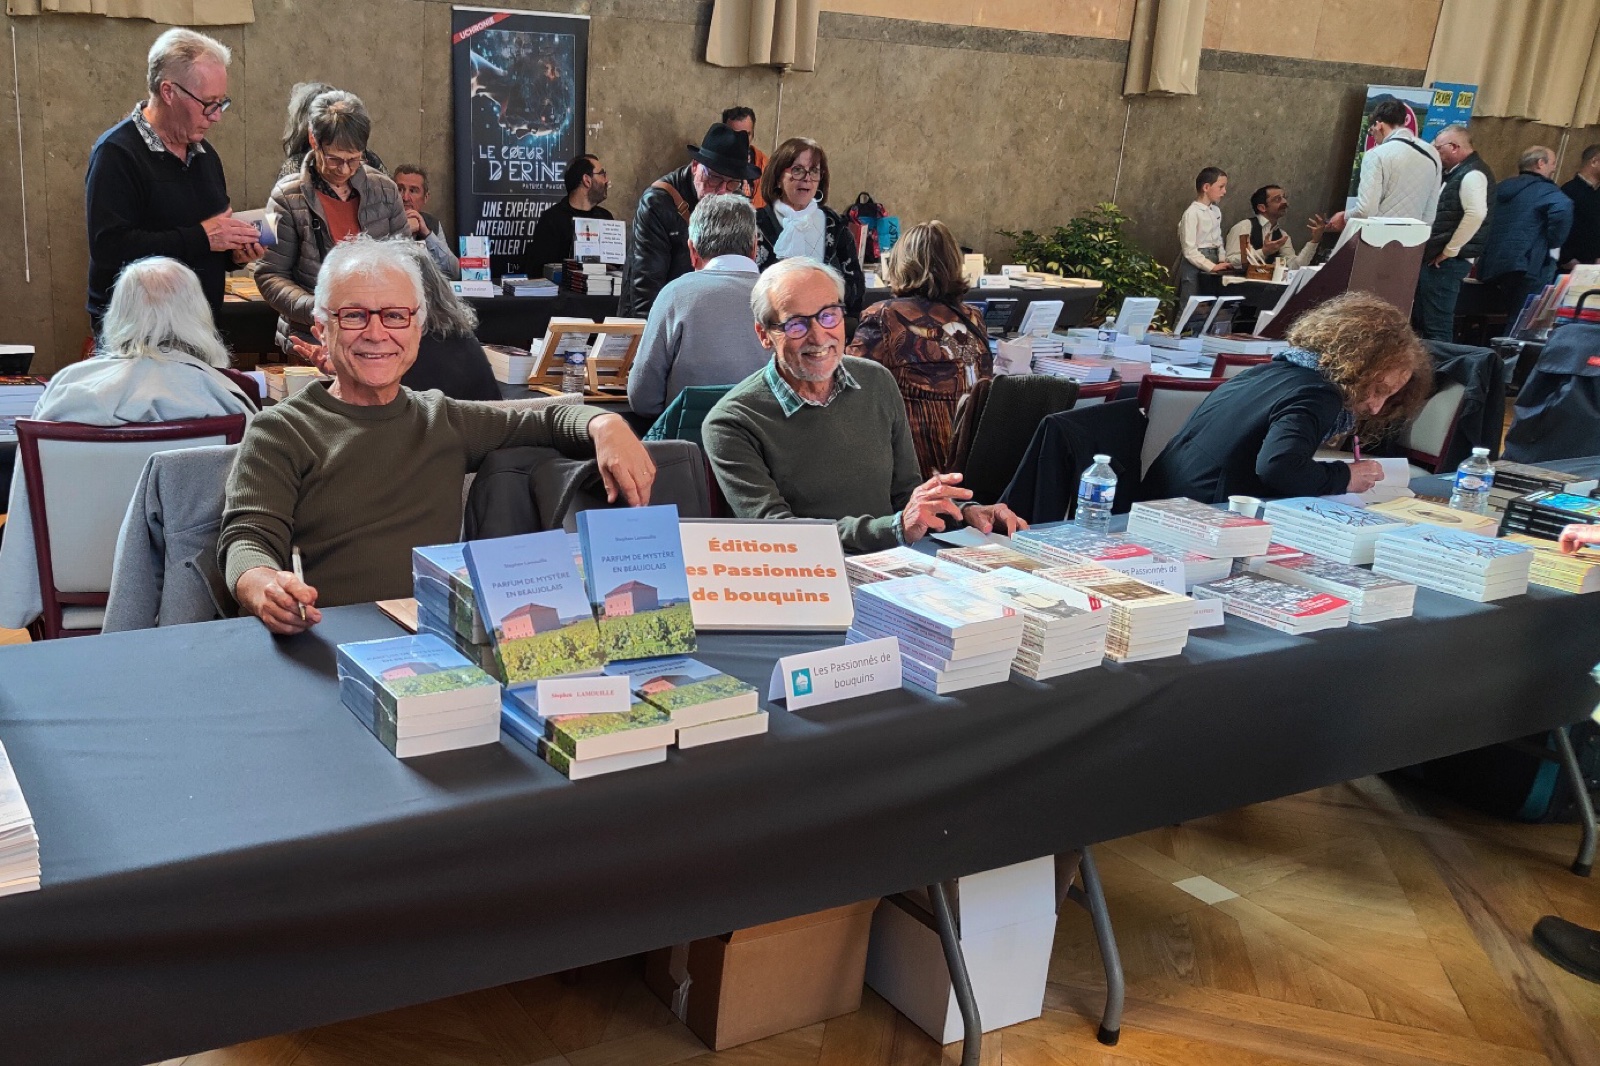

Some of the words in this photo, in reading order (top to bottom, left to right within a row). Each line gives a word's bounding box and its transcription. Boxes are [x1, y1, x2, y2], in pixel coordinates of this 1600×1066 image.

[459, 16, 496, 39] UCHRONIE
[479, 145, 495, 159] LE
[482, 201, 503, 218] UNE
[504, 198, 557, 218] EXPÉRIEN
[475, 219, 525, 236] INTERDITE
[489, 239, 520, 255] CILLER
[708, 537, 798, 553] Éditions
[601, 555, 631, 563] PARFUM
[643, 550, 675, 559] MYSTÈRE
[624, 563, 667, 573] BEAUJOLAIS
[685, 565, 708, 576] es
[713, 563, 837, 578] Passionnés
[1130, 565, 1168, 576] Passionnés
[1169, 565, 1178, 573] de
[492, 580, 524, 589] PARFUM
[536, 571, 570, 583] MYSTÈRE
[518, 584, 563, 597] BEAUJOLAIS
[692, 587, 719, 602] de
[724, 588, 830, 605] bouquins
[813, 666, 829, 677] Les
[830, 655, 879, 673] Passionnés
[880, 652, 891, 662] de
[834, 673, 875, 688] bouquins
[576, 689, 615, 698] LAMOUILLE
